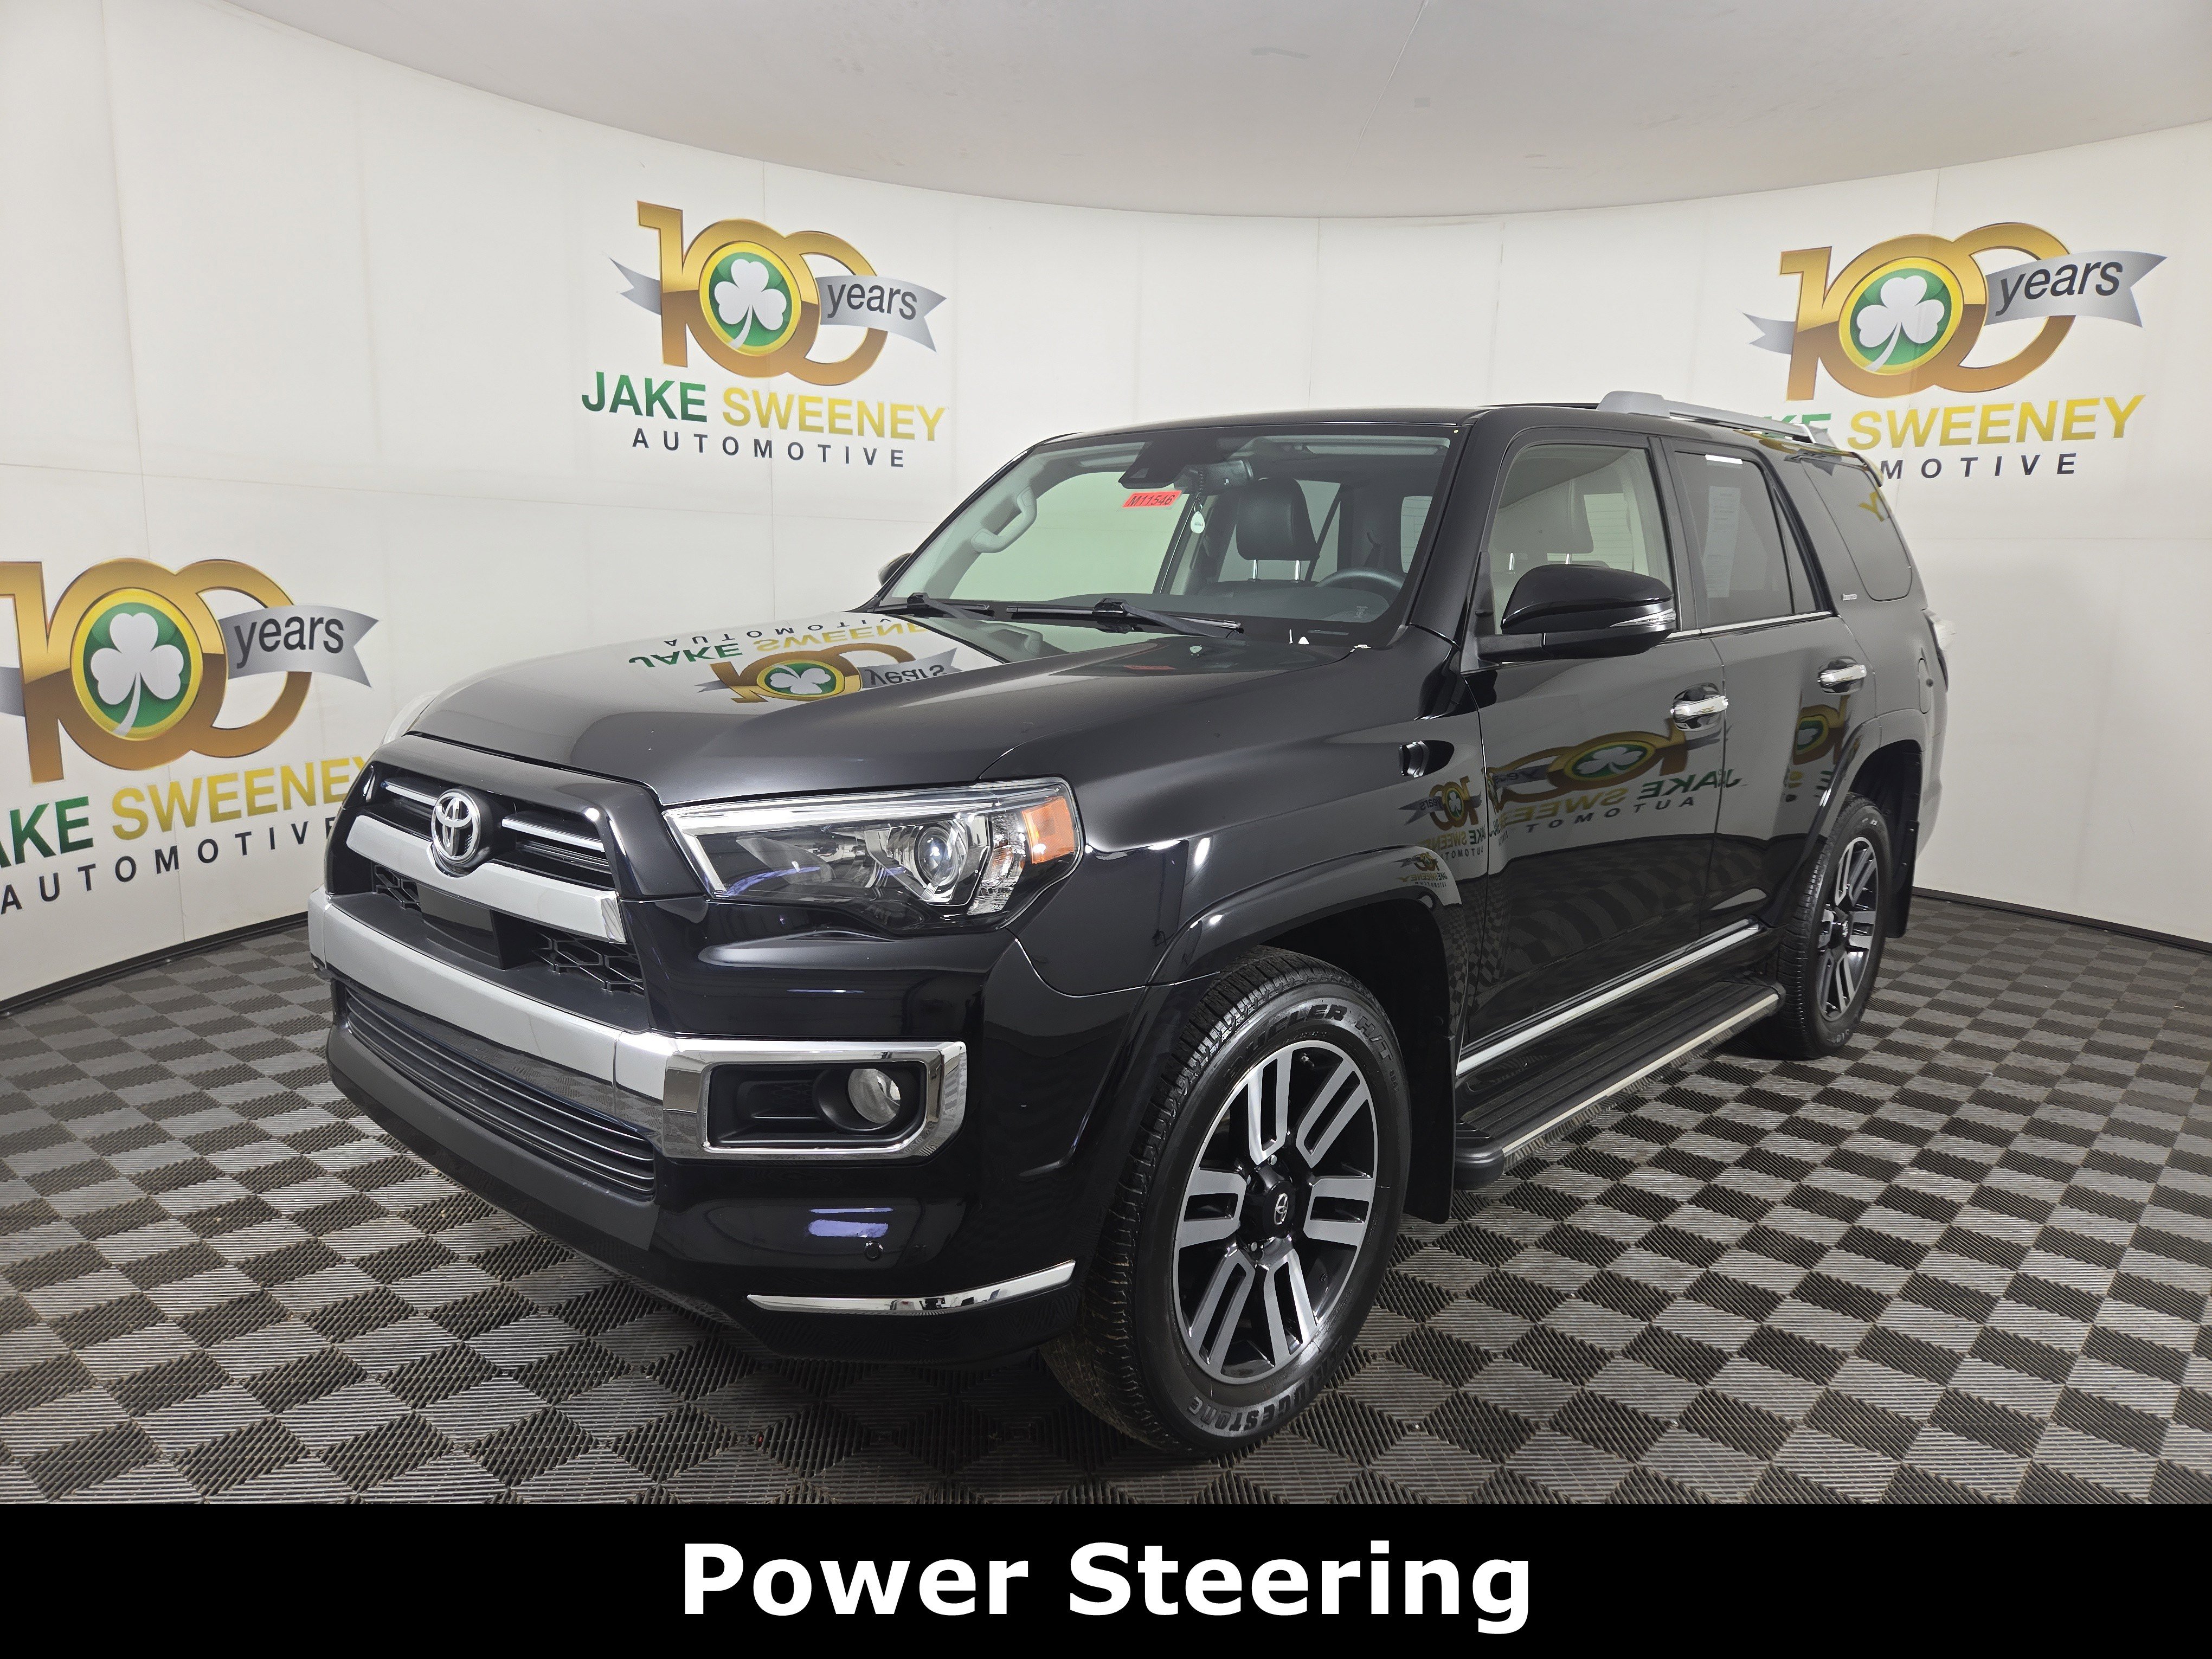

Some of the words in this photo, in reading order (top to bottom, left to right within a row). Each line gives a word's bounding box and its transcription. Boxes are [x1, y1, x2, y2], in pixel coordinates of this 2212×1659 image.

[636, 201, 888, 386] 100
[827, 282, 917, 320] years
[1780, 222, 2075, 401] 100
[1995, 261, 2123, 316] years
[581, 371, 708, 423] JAKE
[722, 387, 946, 442] SWEENEY
[1846, 394, 2146, 451] SWEENEY
[632, 428, 905, 468] AUTOMOTIVE
[1880, 453, 2078, 480] MOTIVE
[1127, 494, 1175, 506] M11546
[234, 616, 345, 669] years
[0, 557, 312, 785] 100
[0, 795, 94, 869] KE
